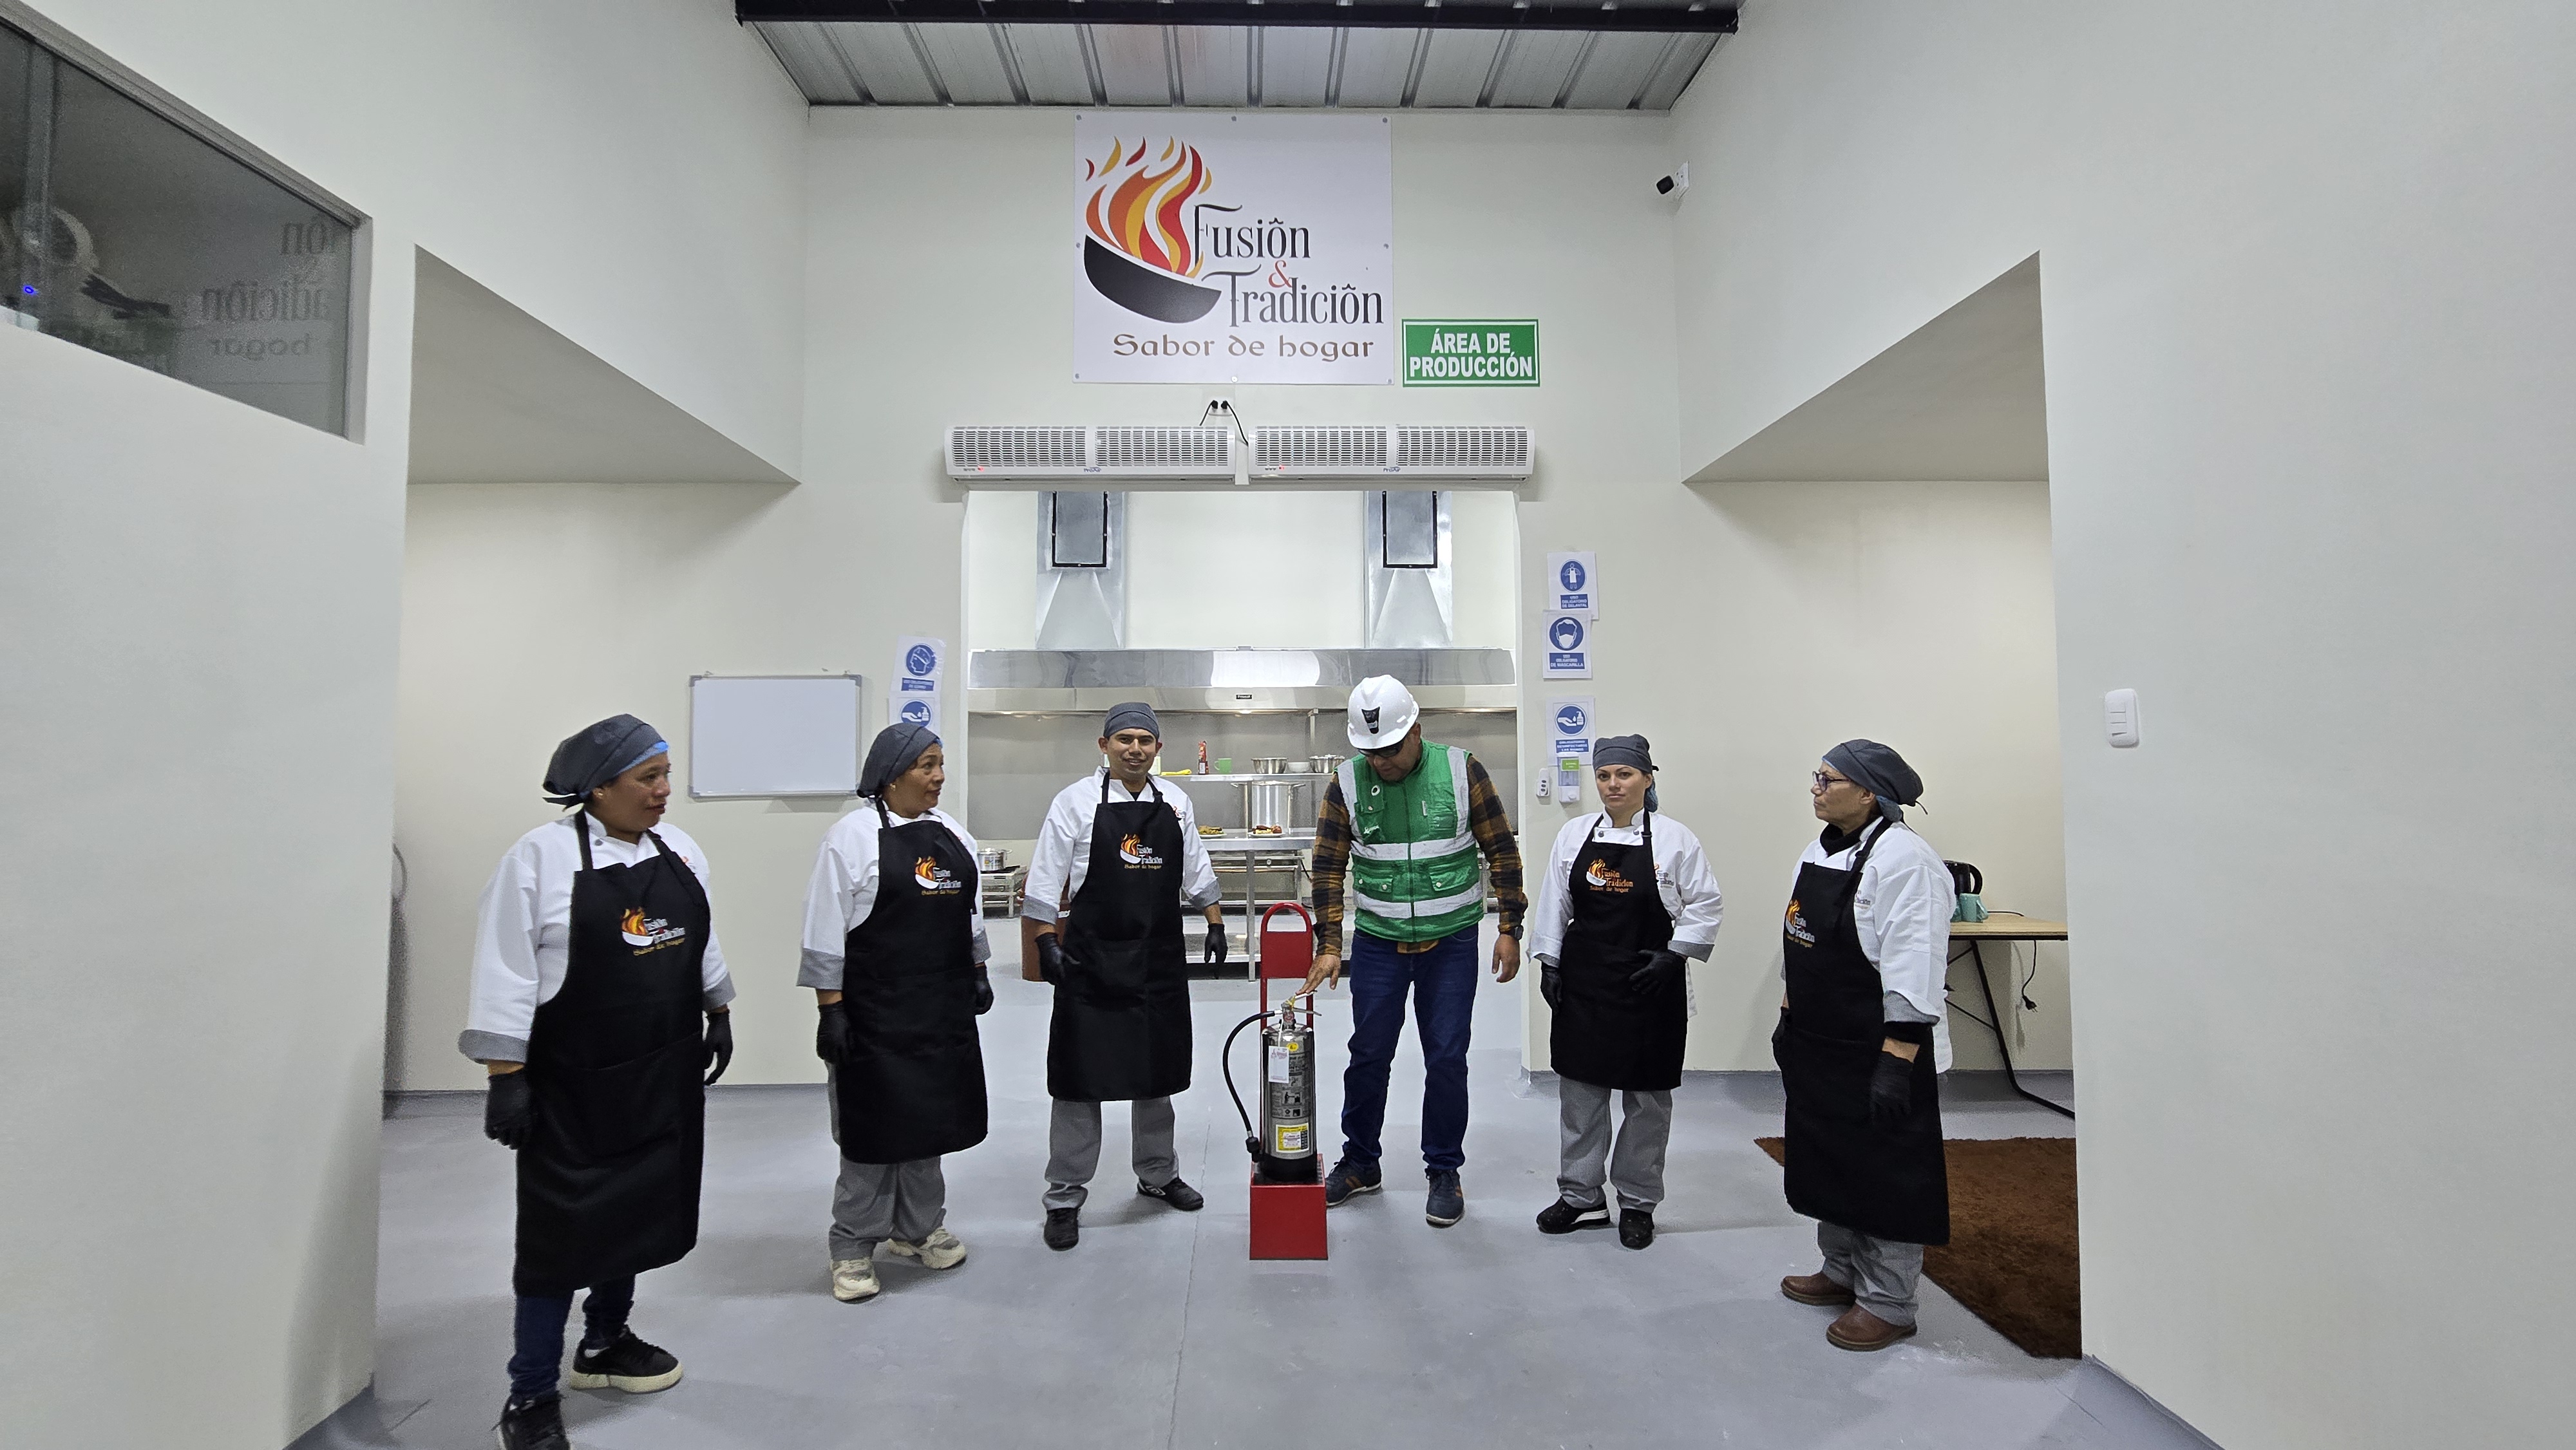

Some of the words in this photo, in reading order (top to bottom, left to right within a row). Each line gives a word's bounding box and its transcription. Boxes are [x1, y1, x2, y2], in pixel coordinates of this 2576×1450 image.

[1268, 259, 1293, 288] &
[1113, 334, 1215, 357] Sabor
[1228, 334, 1265, 357] de
[1279, 334, 1374, 362] hogar
[1430, 328, 1481, 354] ÁREA
[1486, 332, 1511, 353] DE
[1410, 352, 1533, 377] PRODUCCIÓN
